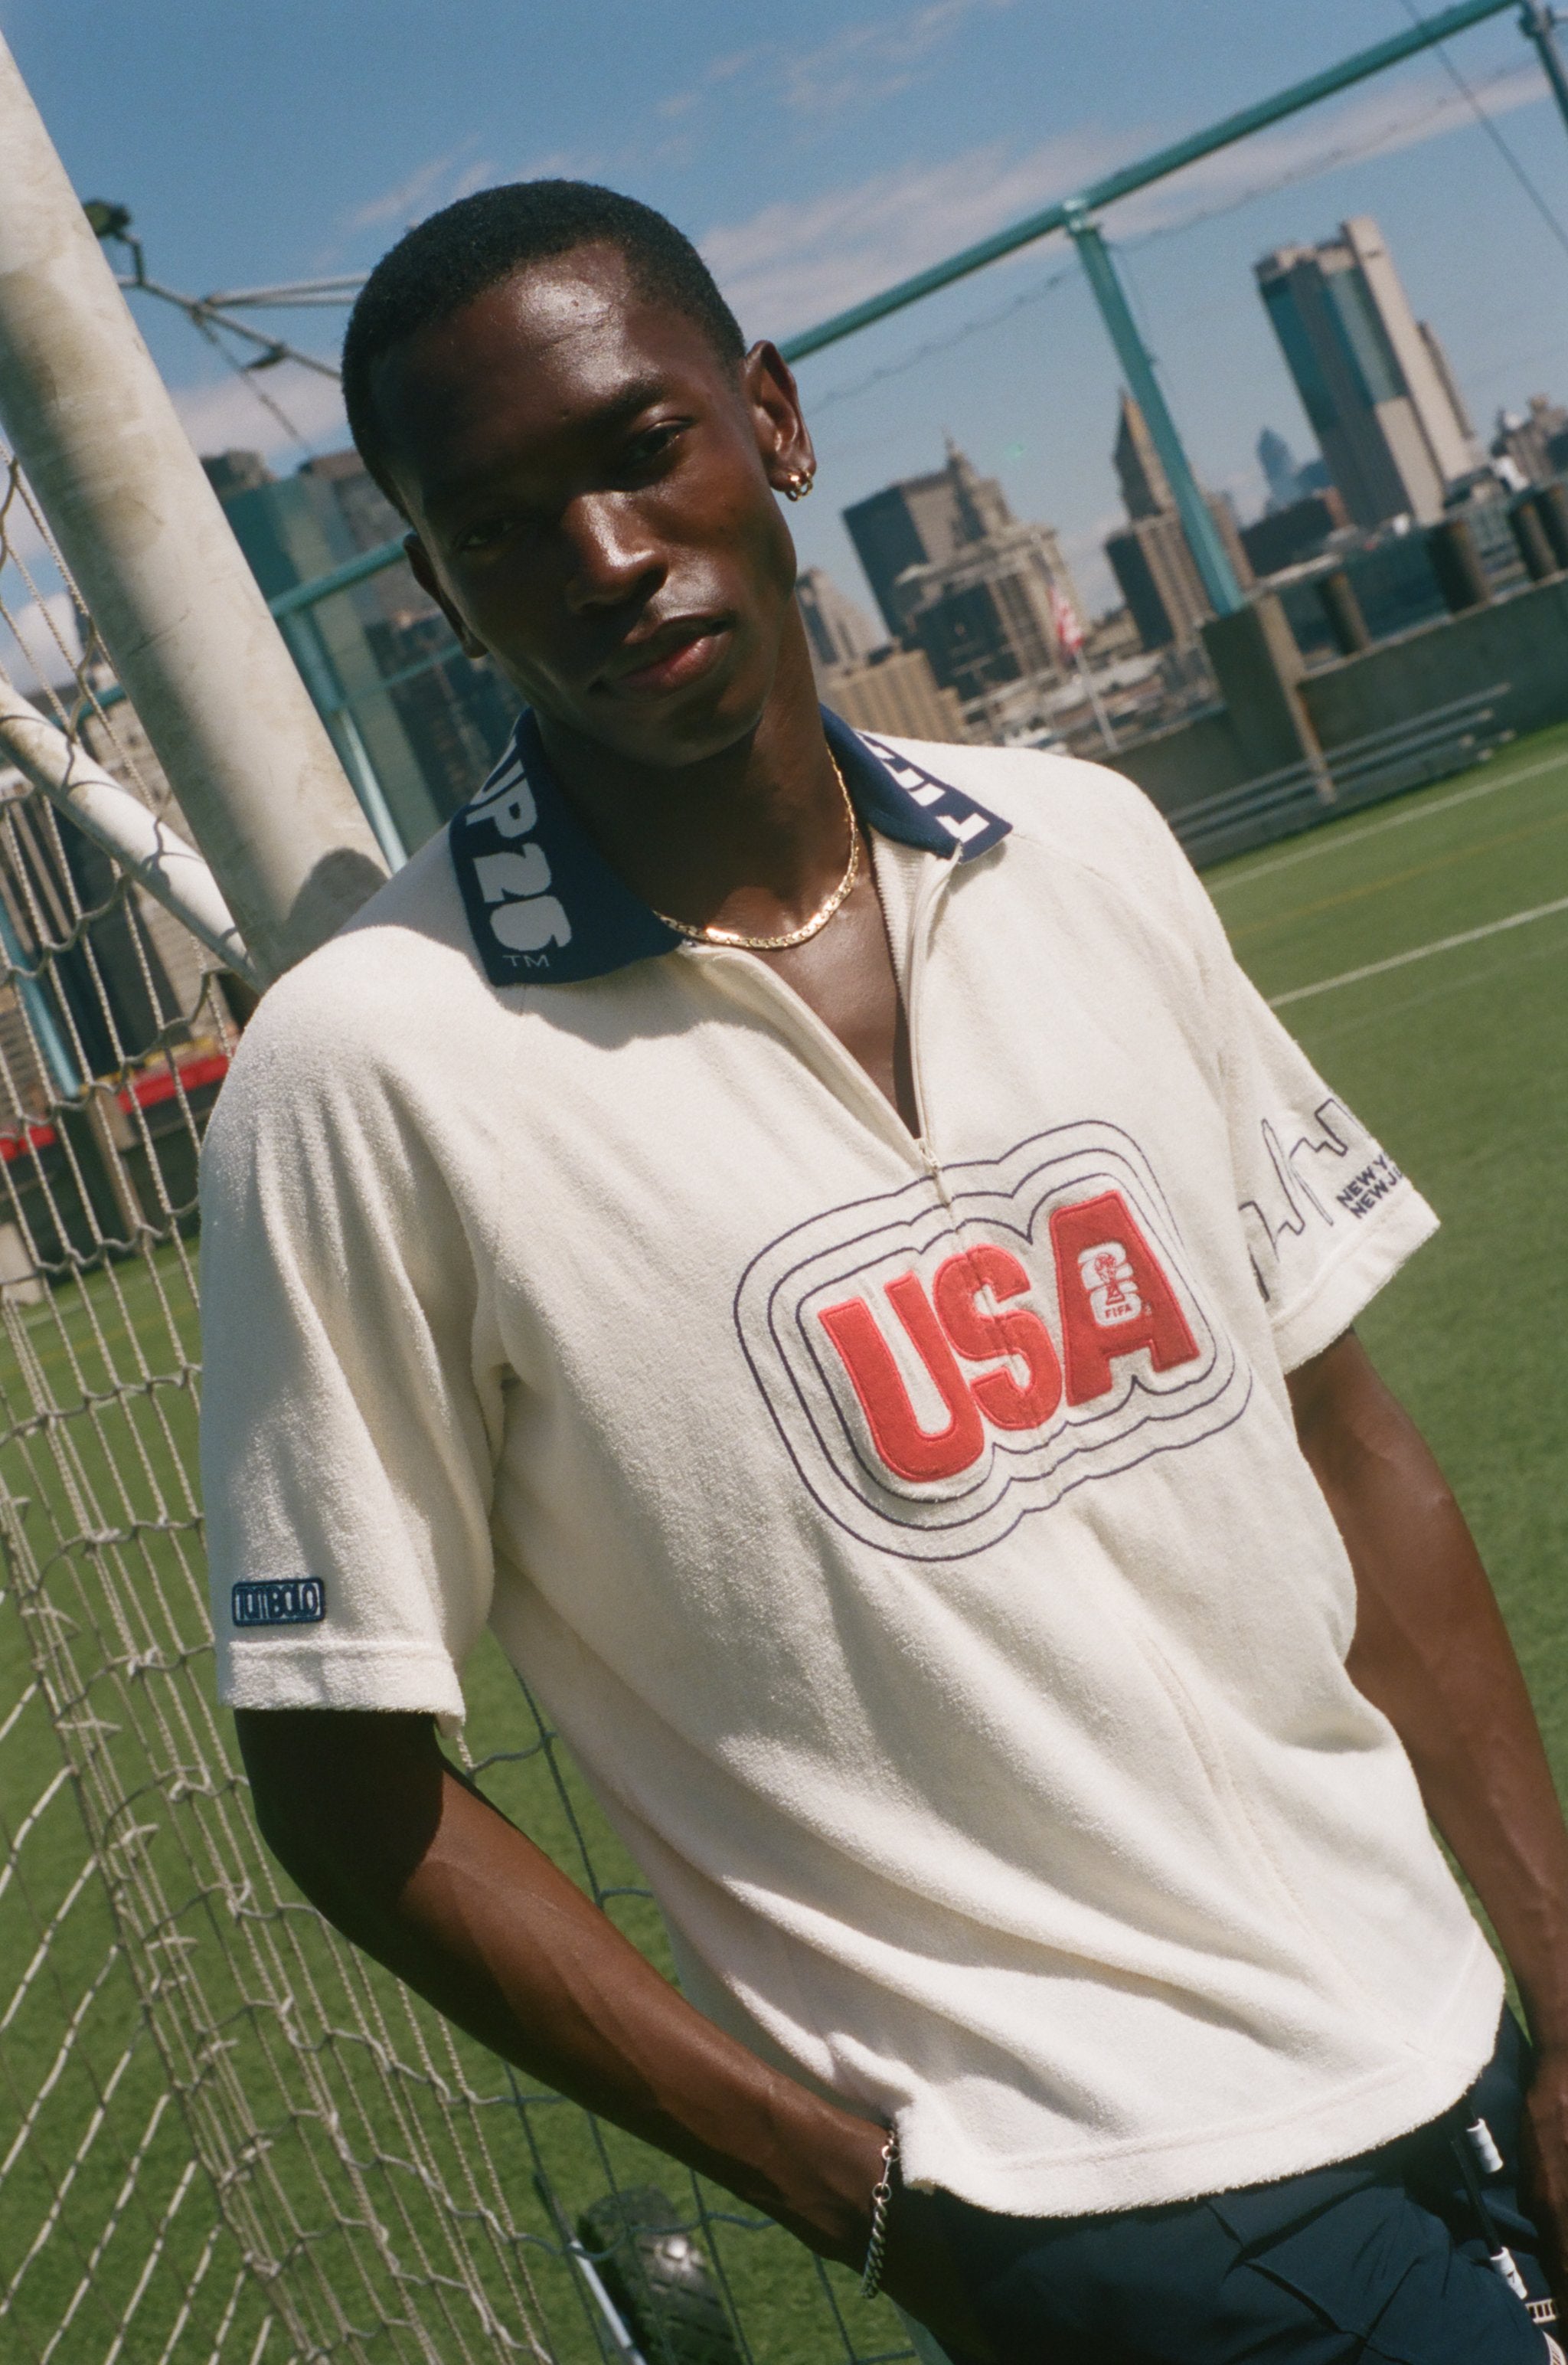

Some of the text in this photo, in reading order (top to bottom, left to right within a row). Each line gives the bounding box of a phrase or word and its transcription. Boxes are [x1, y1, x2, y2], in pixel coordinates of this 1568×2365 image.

[472, 842, 573, 951] 26
[501, 954, 550, 967] TM
[1336, 1166, 1377, 1208] NEW
[1348, 1182, 1389, 1219] NEW
[1105, 1304, 1132, 1318] FIFA
[817, 1189, 1200, 1483] USA
